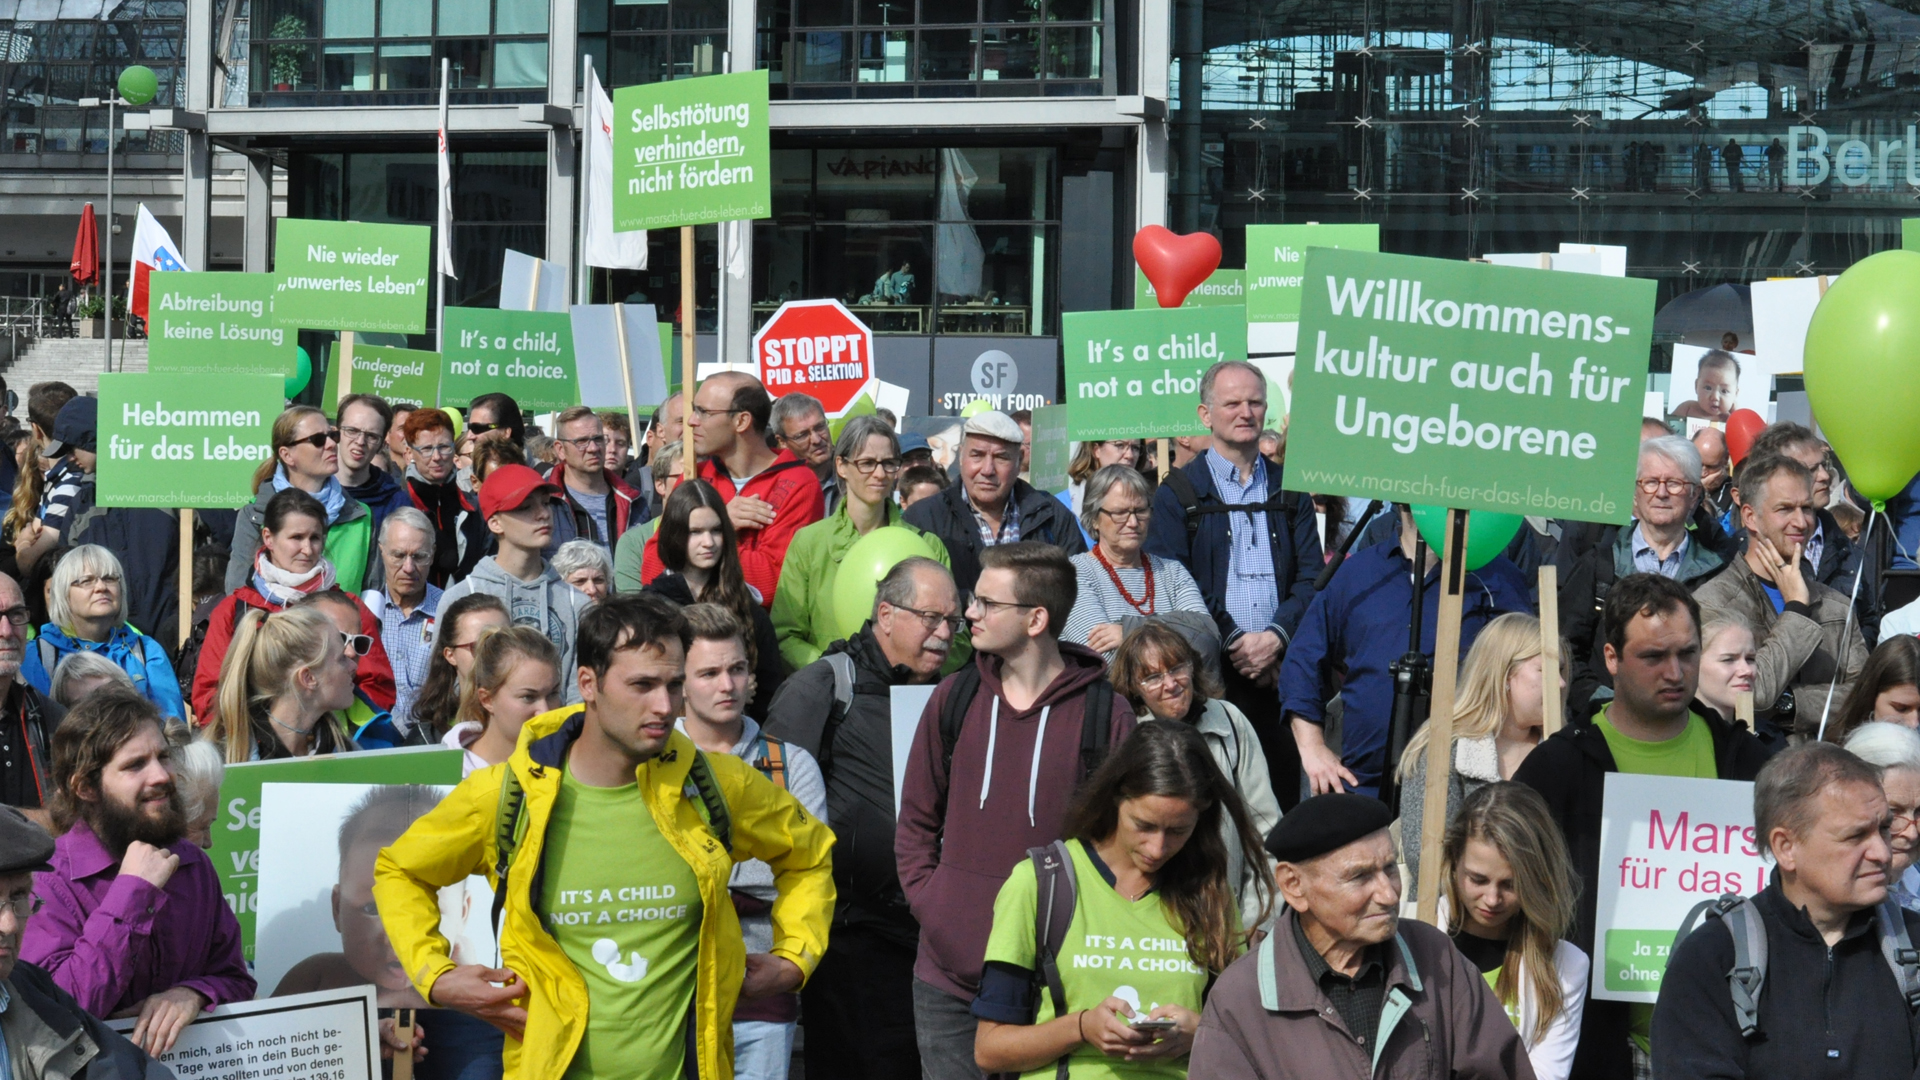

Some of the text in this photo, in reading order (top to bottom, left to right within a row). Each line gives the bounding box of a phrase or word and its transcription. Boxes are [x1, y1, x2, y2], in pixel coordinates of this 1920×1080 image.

[631, 103, 749, 133] Selbsttötung
[634, 130, 745, 163] verhindern,
[1788, 125, 1920, 186] Berl
[629, 159, 753, 195] nicht fördern
[619, 202, 764, 227] www.marsch-fuer-das-leben.de
[307, 244, 399, 266] Nie wieder
[1274, 246, 1299, 262] Nie
[1250, 275, 1303, 291] „unwer
[159, 292, 263, 318] Abtreibung
[1326, 275, 1631, 343] Willkommens-
[164, 320, 284, 346] keine Lösung
[279, 316, 420, 332] www.marsch-fuer-das-leben.de
[460, 329, 561, 355] It's a child,
[764, 333, 861, 367] STOPPT
[1088, 332, 1224, 363] It's a child,
[450, 357, 568, 379] not a choice.
[766, 362, 863, 385] PID & SELEKTION
[981, 362, 1008, 388] SF
[1314, 330, 1631, 403] kultur auch für
[373, 374, 393, 389] für
[1079, 369, 1202, 399] not a choi
[122, 401, 260, 427] Hebammen
[1007, 394, 1044, 411] FOOD
[1335, 395, 1598, 460] Ungeborene
[109, 434, 273, 460] für das Leben
[1301, 469, 1617, 515] www.marsch-fuer-das-leben.de
[1619, 857, 1667, 890] für
[1678, 862, 1742, 895] das
[598, 889, 613, 903] A
[618, 884, 676, 901] CHILD
[550, 904, 687, 925] NOT A CHOICE
[1120, 937, 1135, 950] A
[1632, 940, 1651, 956] Ja
[1073, 954, 1115, 969] NOT
[1118, 956, 1133, 970] A
[1619, 964, 1661, 981] ohne
[179, 1046, 211, 1059] mich,
[215, 1043, 232, 1054] als
[236, 1039, 254, 1051] ich
[258, 1034, 287, 1048] noch
[291, 1030, 319, 1043] nicht
[323, 1028, 342, 1039] be-
[176, 1043, 342, 1075] Tage waren in dein Buch ge-
[222, 1070, 259, 1080] sollten
[263, 1064, 284, 1076] und
[287, 1063, 307, 1073] von
[310, 1057, 344, 1070] denen
